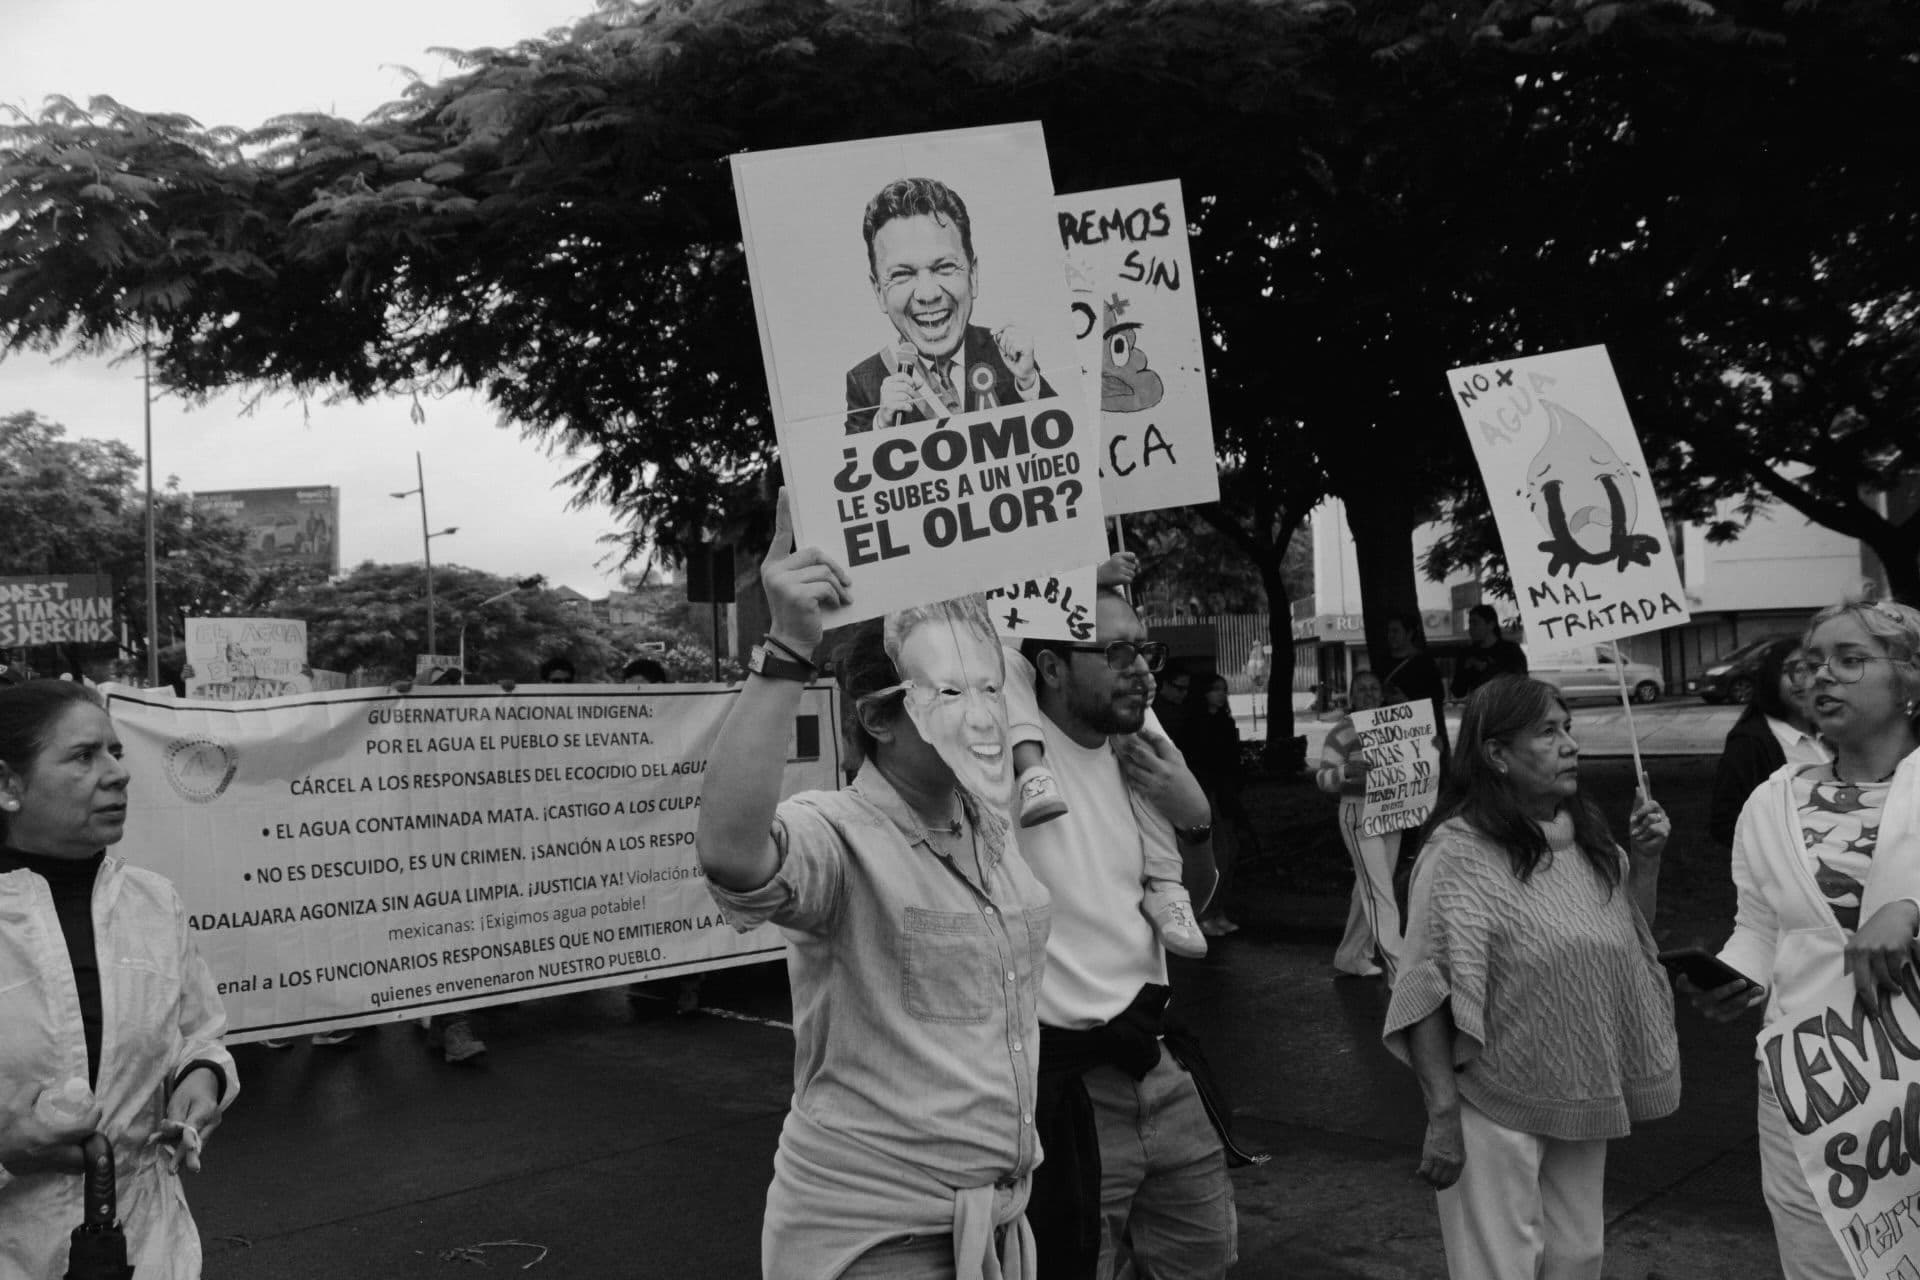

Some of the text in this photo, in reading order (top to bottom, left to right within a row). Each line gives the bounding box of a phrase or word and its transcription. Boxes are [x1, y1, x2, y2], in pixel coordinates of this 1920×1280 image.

[1058, 202, 1171, 250] REMOS
[1118, 250, 1180, 291] SIN
[1458, 374, 1490, 408] NO
[1479, 372, 1557, 446] AGUA
[833, 409, 1074, 493] ¿CÓMO
[1098, 424, 1177, 478] CA
[837, 452, 1080, 523] LE SUBES A UN VÍDEO
[843, 479, 1083, 568] EL OLOR?
[16, 597, 112, 621] MARCHAN
[1528, 581, 1601, 608] MAL
[18, 619, 113, 645] DERECHOS
[1538, 592, 1682, 640] TRATADA
[368, 705, 653, 724] GUBERNATURA NACIONAL INDIGENA:
[1372, 704, 1413, 726] JALISCO
[366, 732, 654, 754] POR EL AGUA EL PUEBLO SE LEVANTA.
[1359, 725, 1403, 748] ESTADO
[1410, 738, 1420, 759] Y
[290, 776, 355, 795] CÁRCEL
[360, 777, 372, 791] A
[379, 775, 409, 791] LOS
[414, 769, 531, 789] RESPONSABLES
[535, 768, 561, 782] DEL
[565, 764, 637, 780] ECOCIDIO
[642, 763, 668, 777] DEL
[1413, 761, 1430, 780] NO
[276, 824, 294, 839] EL
[299, 820, 351, 837] AGUA
[356, 811, 483, 833] CONTAMINADA
[487, 807, 539, 824] MATA.
[543, 802, 610, 822] ¡CASTIGO
[614, 801, 625, 815] A
[629, 799, 655, 814] LOS
[1363, 805, 1429, 836] GOBIERNO
[257, 831, 695, 883] NO ES DESCUIDO, ES UN CRIMEN. ¡SANCIÓN A LOS RESPO
[300, 899, 377, 921] AGONIZA
[382, 895, 409, 912] SIN
[413, 889, 462, 908] AGUA
[466, 883, 523, 903] LIMPIA.
[528, 876, 597, 897] ¡JUSTICIA
[600, 872, 623, 887] YA!
[627, 865, 689, 885] Violación
[388, 896, 646, 941] mexicanas: ¡Exigimos agua potable!
[217, 975, 257, 995] enal
[262, 978, 272, 989] a
[280, 970, 312, 988] LOS
[316, 952, 438, 983] FUNCIONARIOS
[443, 936, 555, 965] RESPONSABLES
[559, 931, 589, 949] QUE
[593, 928, 615, 943] NO
[619, 919, 692, 941] EMITIERON
[697, 915, 712, 929] LA
[371, 947, 667, 1007] quienes envenenaron NUESTRO PUEBLO.
